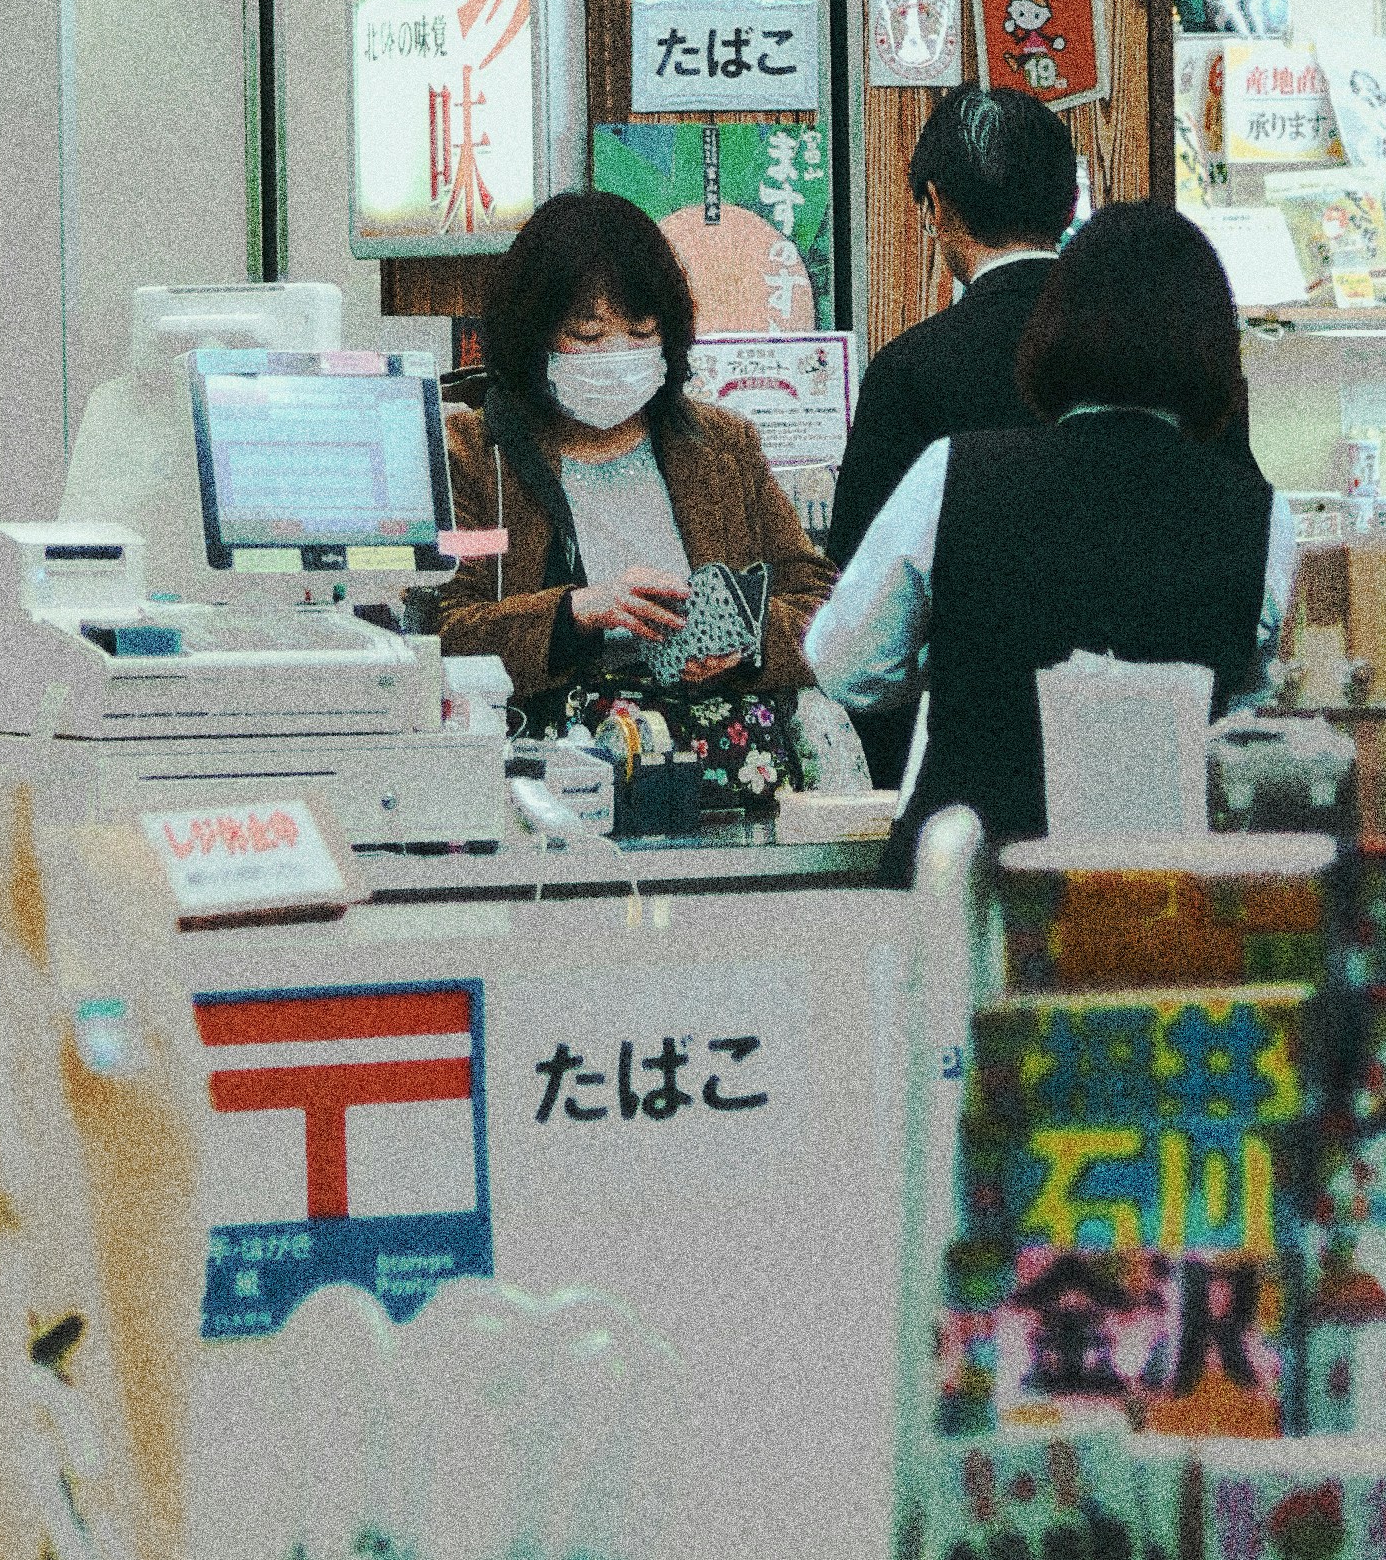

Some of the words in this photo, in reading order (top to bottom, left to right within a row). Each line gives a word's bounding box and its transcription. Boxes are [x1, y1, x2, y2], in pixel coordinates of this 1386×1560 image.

[655, 27, 799, 82] たばこ
[1245, 64, 1328, 94] 産地直
[759, 132, 808, 333] ますのす
[535, 1034, 769, 1123] たばこ
[1027, 1128, 1273, 1254] 石川
[1013, 1256, 1263, 1396] 金沢
